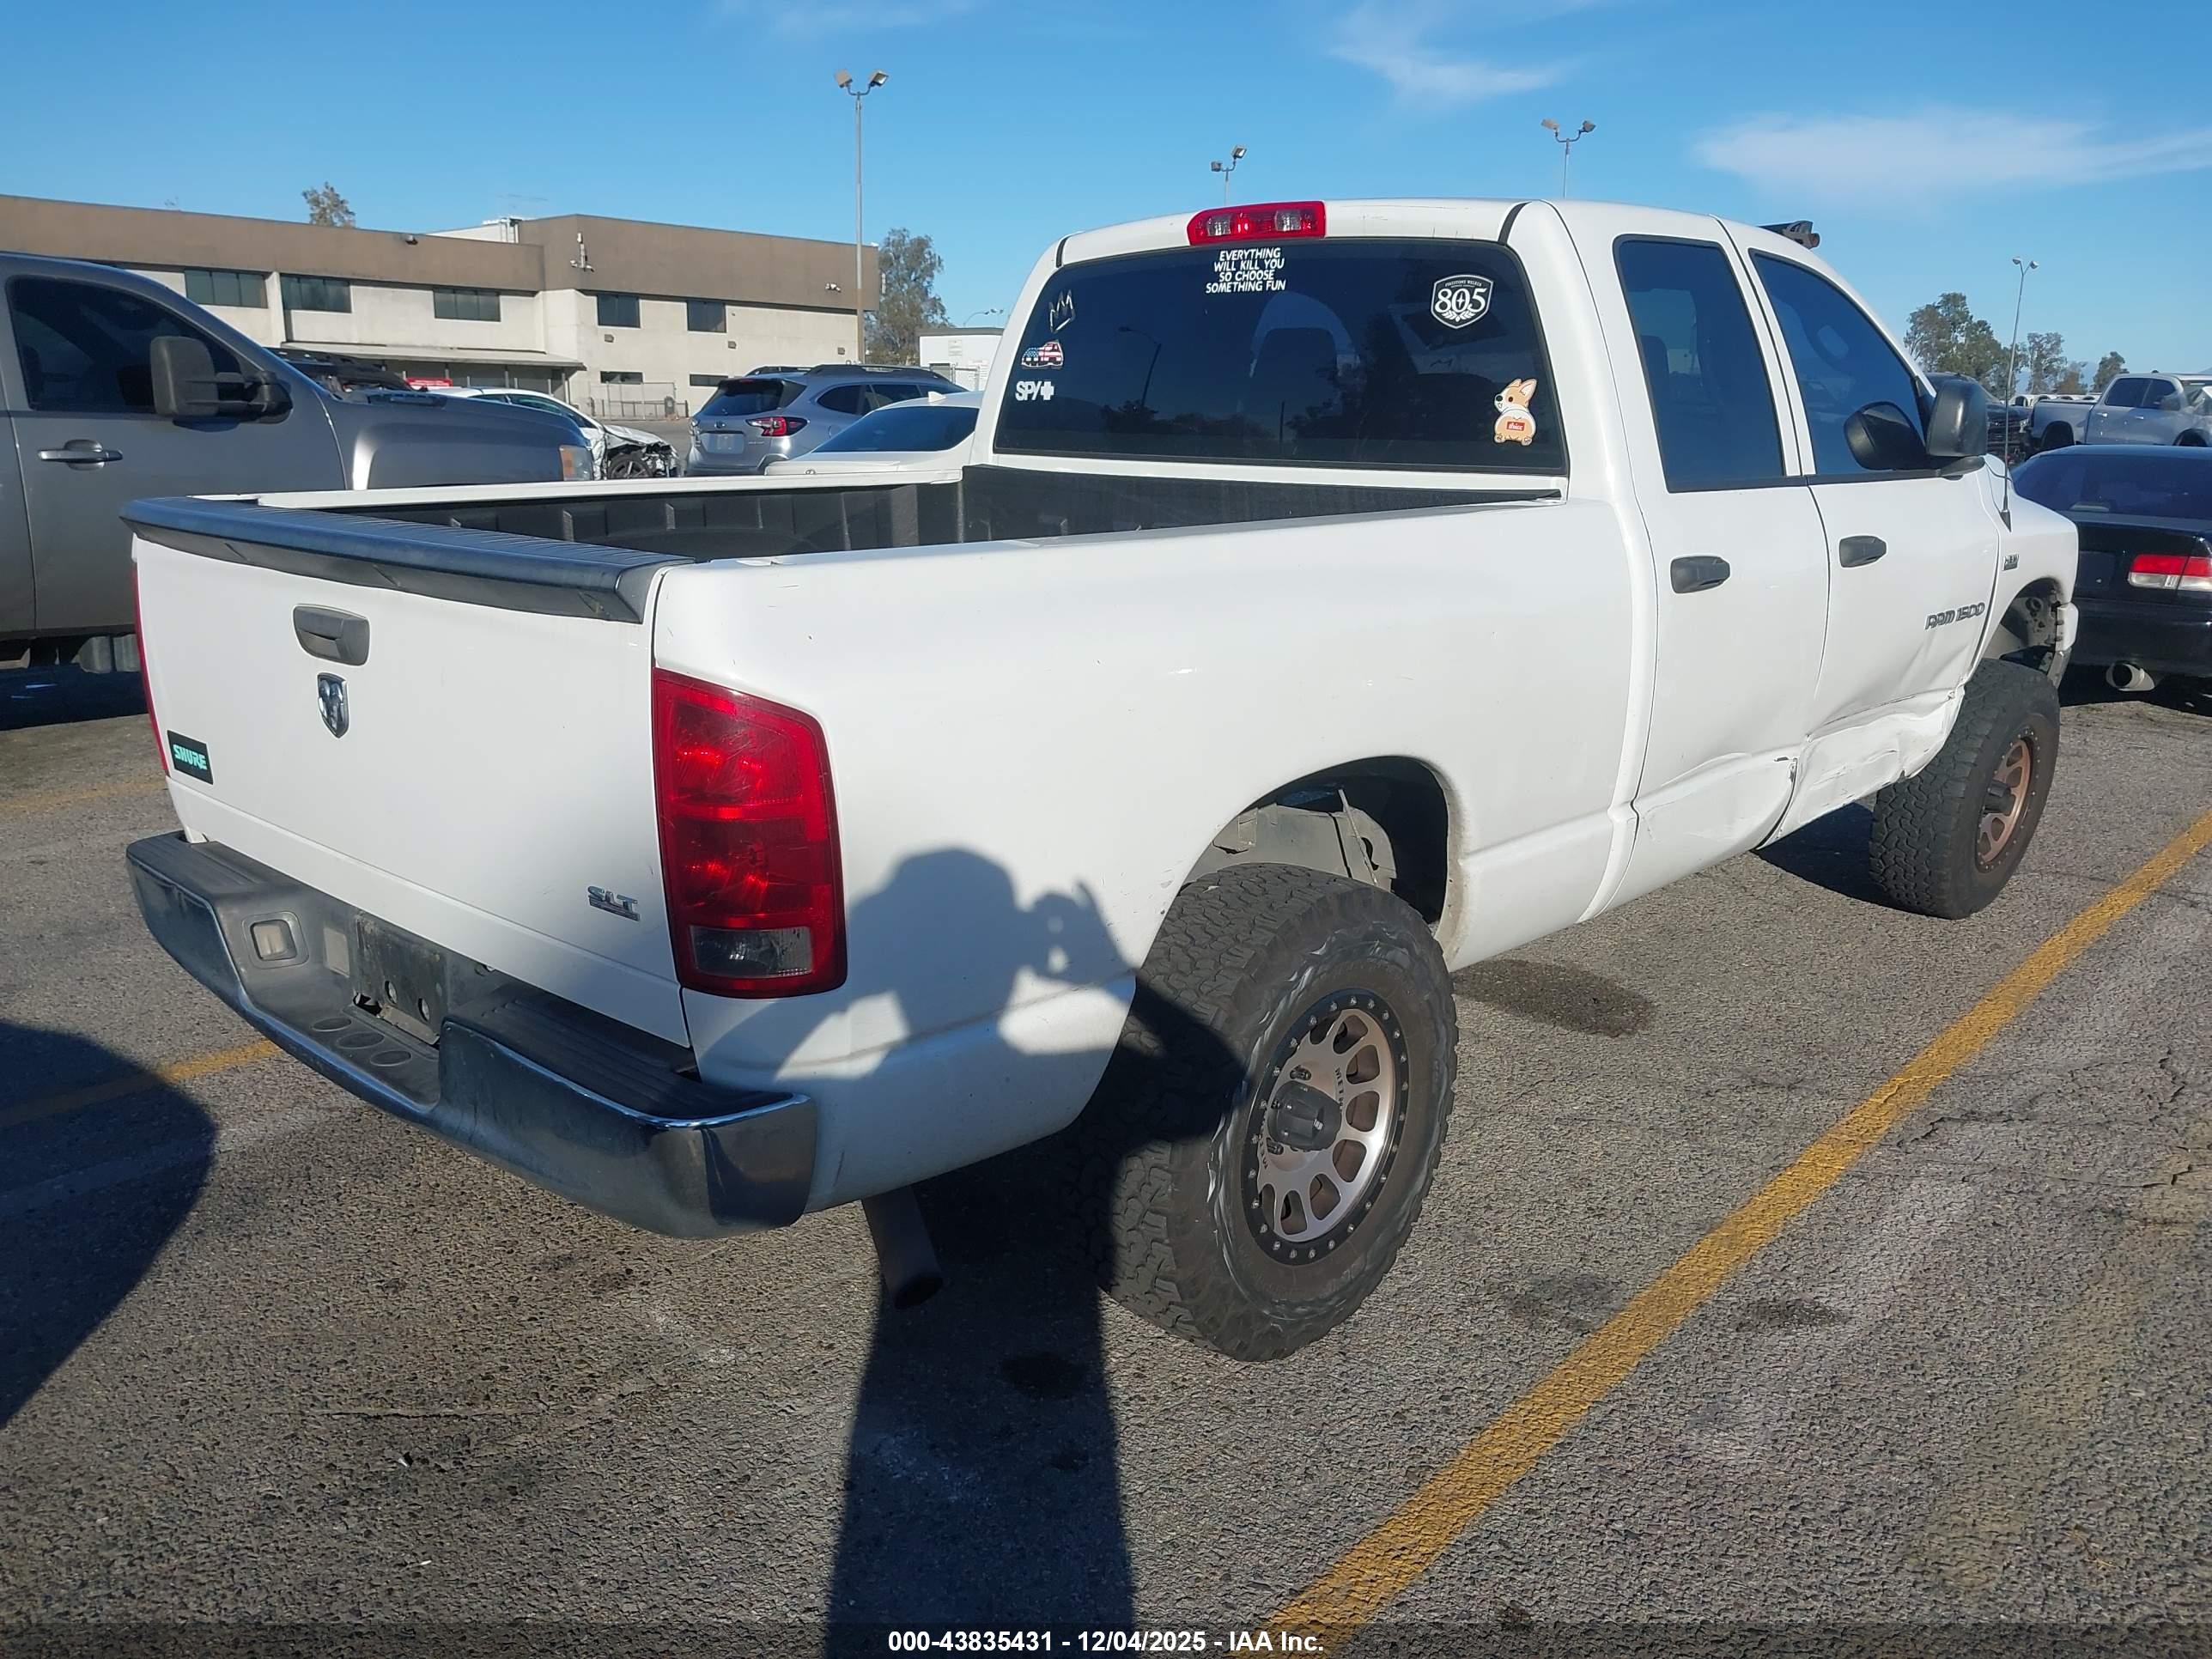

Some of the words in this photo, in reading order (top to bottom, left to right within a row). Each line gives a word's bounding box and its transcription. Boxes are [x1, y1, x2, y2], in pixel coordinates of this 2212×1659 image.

[1219, 247, 1281, 261] EVERYTHING
[1213, 261, 1237, 272] WILL
[1240, 259, 1260, 270] KILL
[1264, 258, 1285, 270] YOU
[1206, 281, 1263, 294] SOMETHING
[1266, 279, 1286, 291] FUN
[1219, 272, 1232, 283] SO
[1235, 270, 1275, 282] CHOOSE
[1434, 288, 1488, 313] 805
[1924, 610, 1956, 630] RAM
[1955, 602, 1986, 623] 1500
[173, 744, 208, 770] SHURE
[587, 885, 638, 913] SLT
